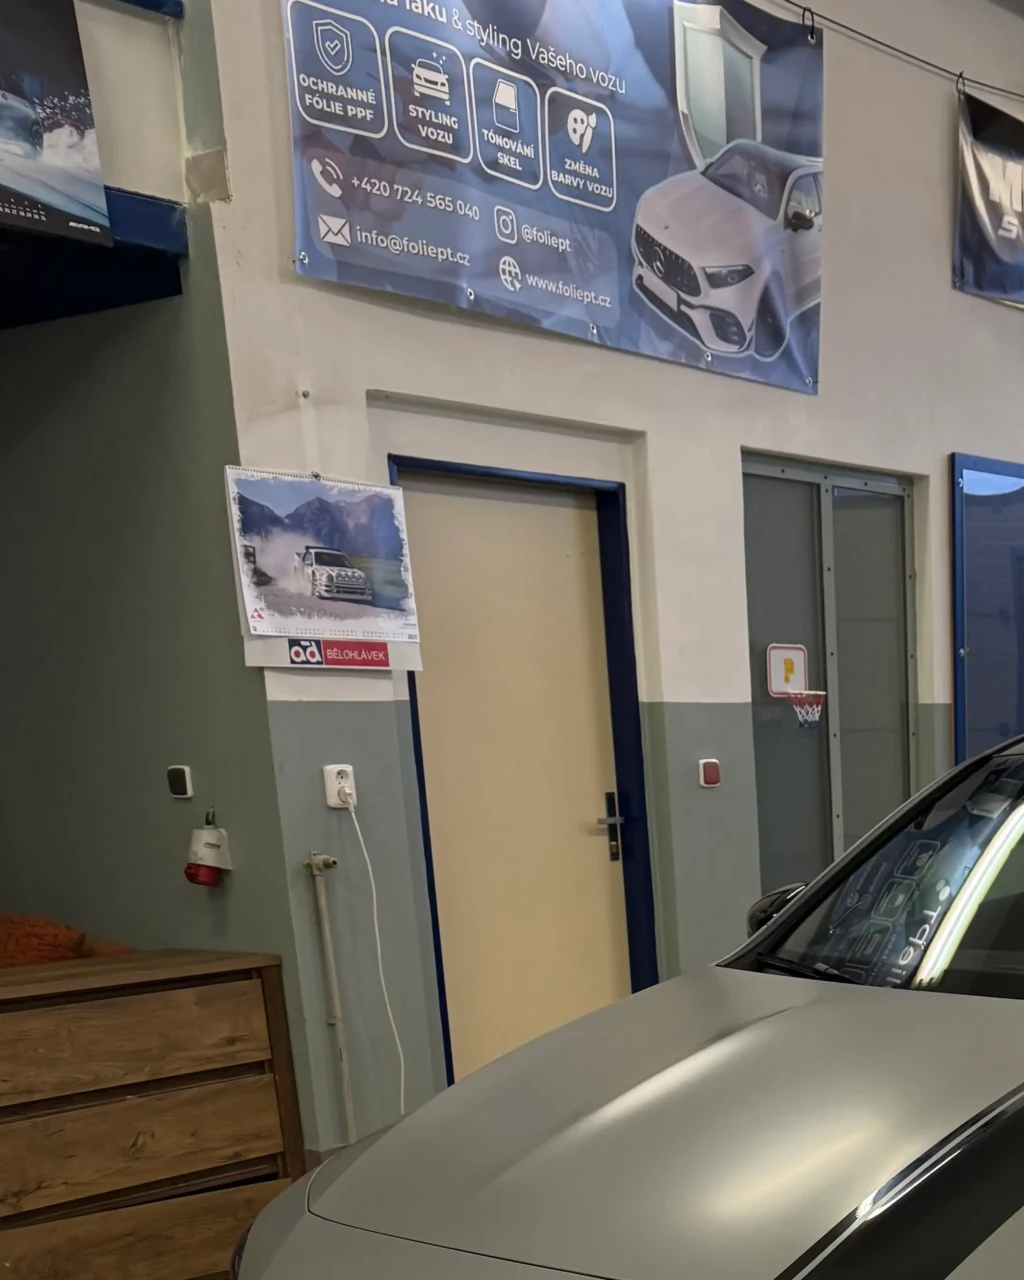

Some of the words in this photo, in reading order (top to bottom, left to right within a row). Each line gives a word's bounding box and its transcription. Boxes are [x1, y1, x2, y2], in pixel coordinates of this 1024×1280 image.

[452, 8, 463, 31] &
[466, 19, 522, 60] styling
[527, 38, 587, 79] Vašeho
[590, 67, 626, 94] vozu
[299, 73, 376, 105] OCHRANNÉ
[305, 93, 344, 115] FÓLIE
[347, 105, 374, 122] PPF
[408, 104, 459, 129] STYLING
[418, 124, 453, 144] VOZU
[482, 129, 535, 159] TÓNOVÁNÍ
[497, 152, 522, 171] SKEL
[564, 158, 600, 179] ZMĚNA
[551, 170, 585, 189] BARVY
[587, 180, 613, 198] VOZU
[351, 177, 390, 197] +420
[394, 184, 423, 205] 724
[427, 192, 453, 212] 565
[457, 200, 480, 220] 040
[356, 226, 470, 266] info@foliept.cz
[521, 225, 571, 252] @foliept
[526, 273, 612, 308] www.foliept.cz
[326, 647, 385, 661] BĚLOHLÁVEK
